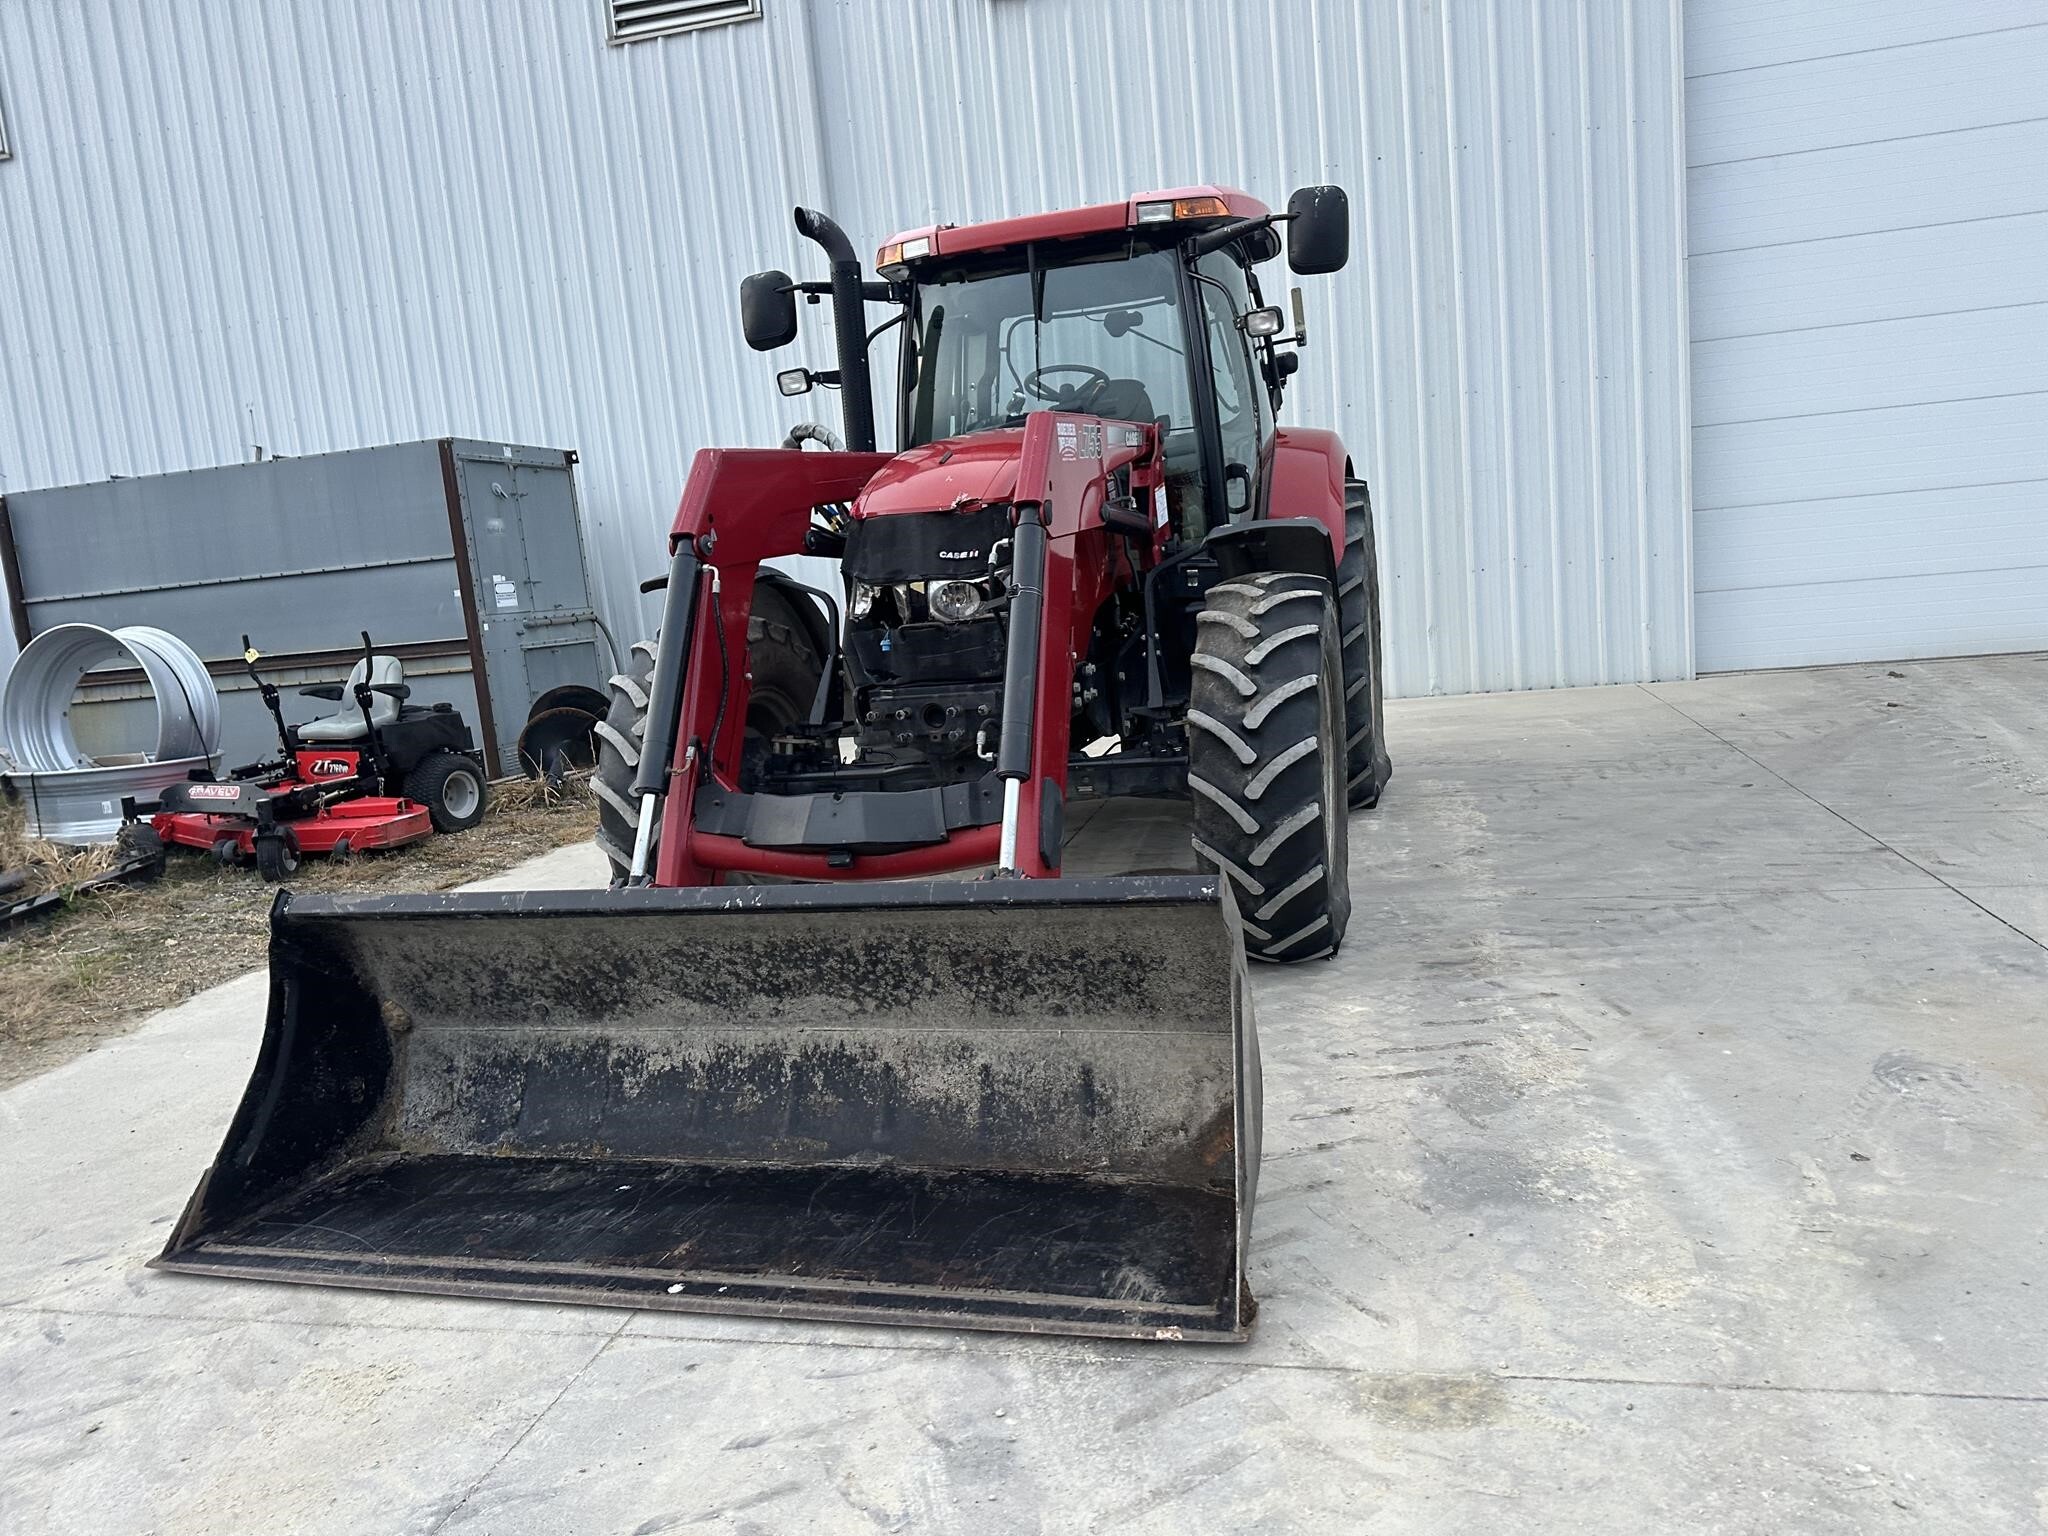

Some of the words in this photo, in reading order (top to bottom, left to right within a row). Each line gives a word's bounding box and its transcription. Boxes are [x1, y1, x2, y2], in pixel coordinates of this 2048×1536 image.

[939, 551, 968, 559] CASE
[313, 759, 331, 774] ZT
[189, 786, 236, 797] GRAVELY
